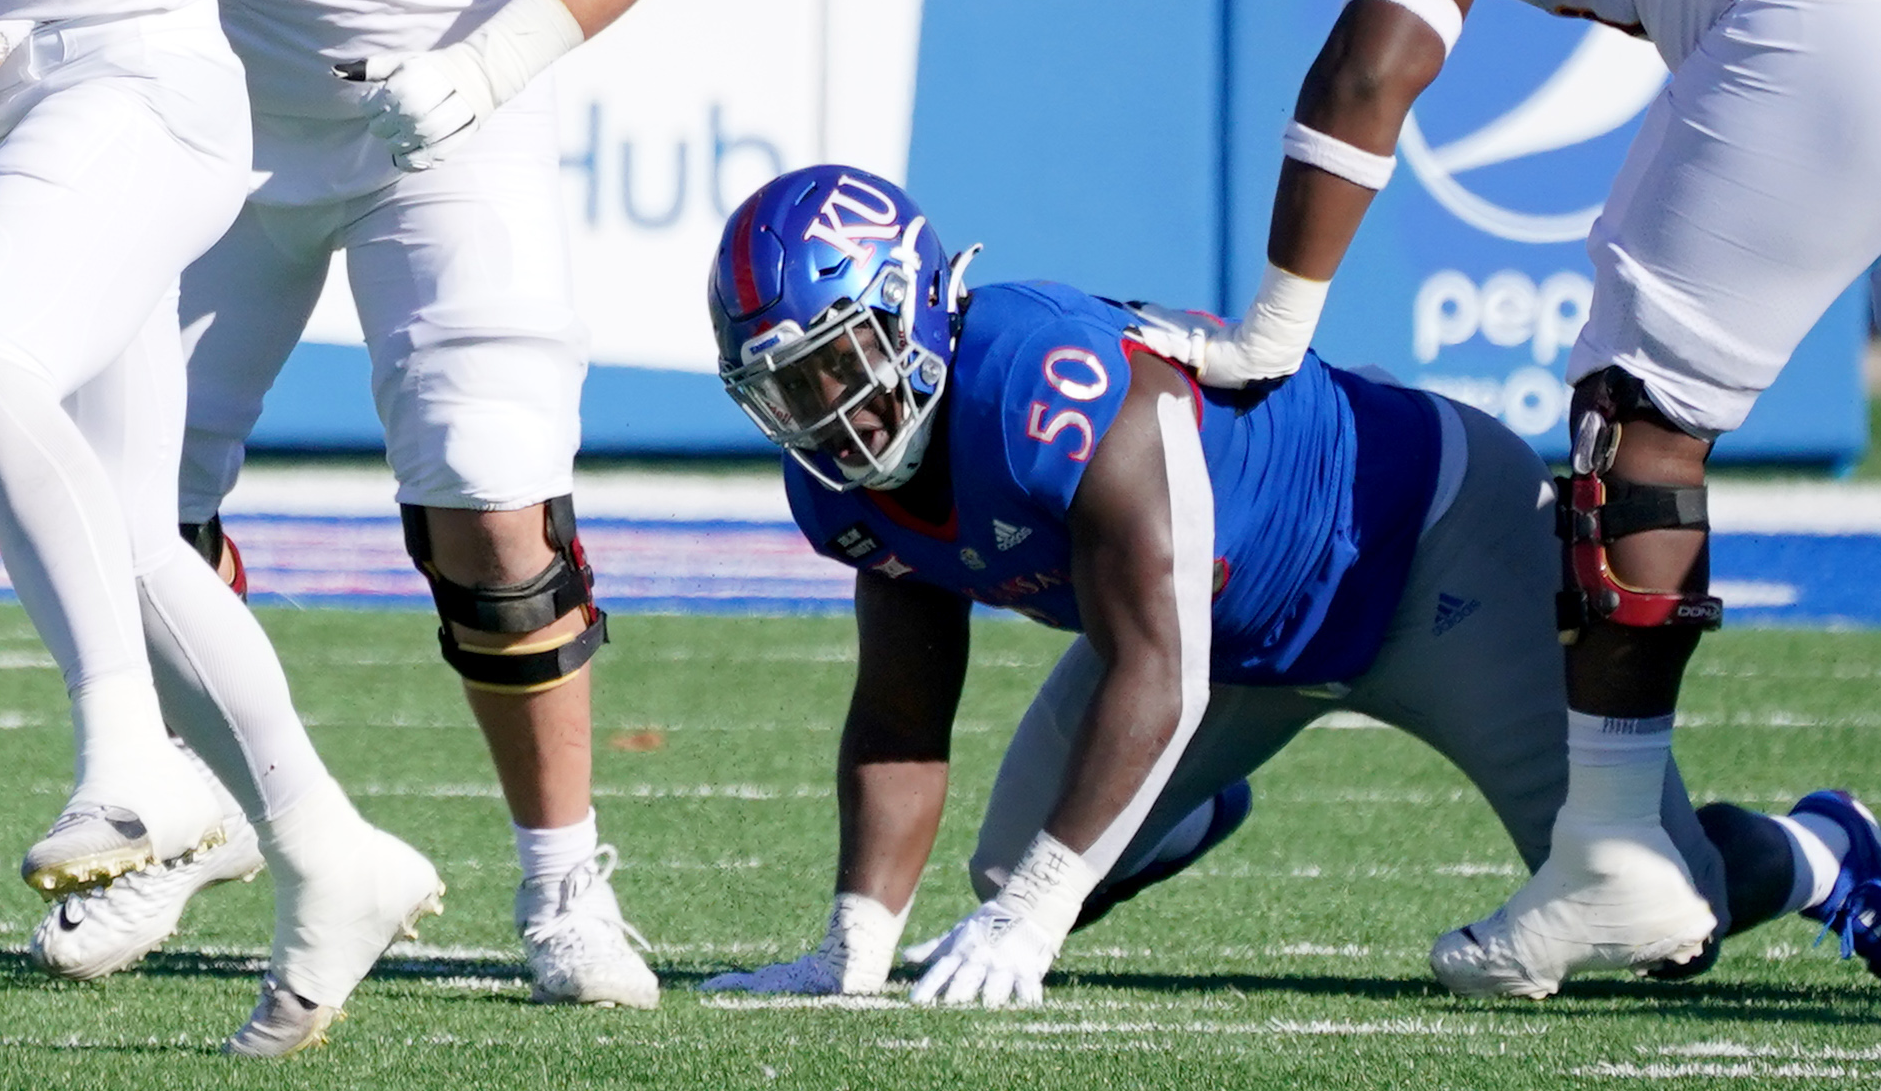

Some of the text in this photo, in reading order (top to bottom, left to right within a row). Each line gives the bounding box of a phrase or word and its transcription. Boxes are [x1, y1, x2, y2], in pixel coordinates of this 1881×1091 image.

[802, 174, 902, 270] KU
[1025, 345, 1111, 462] 50
[996, 525, 1034, 551] adidas
